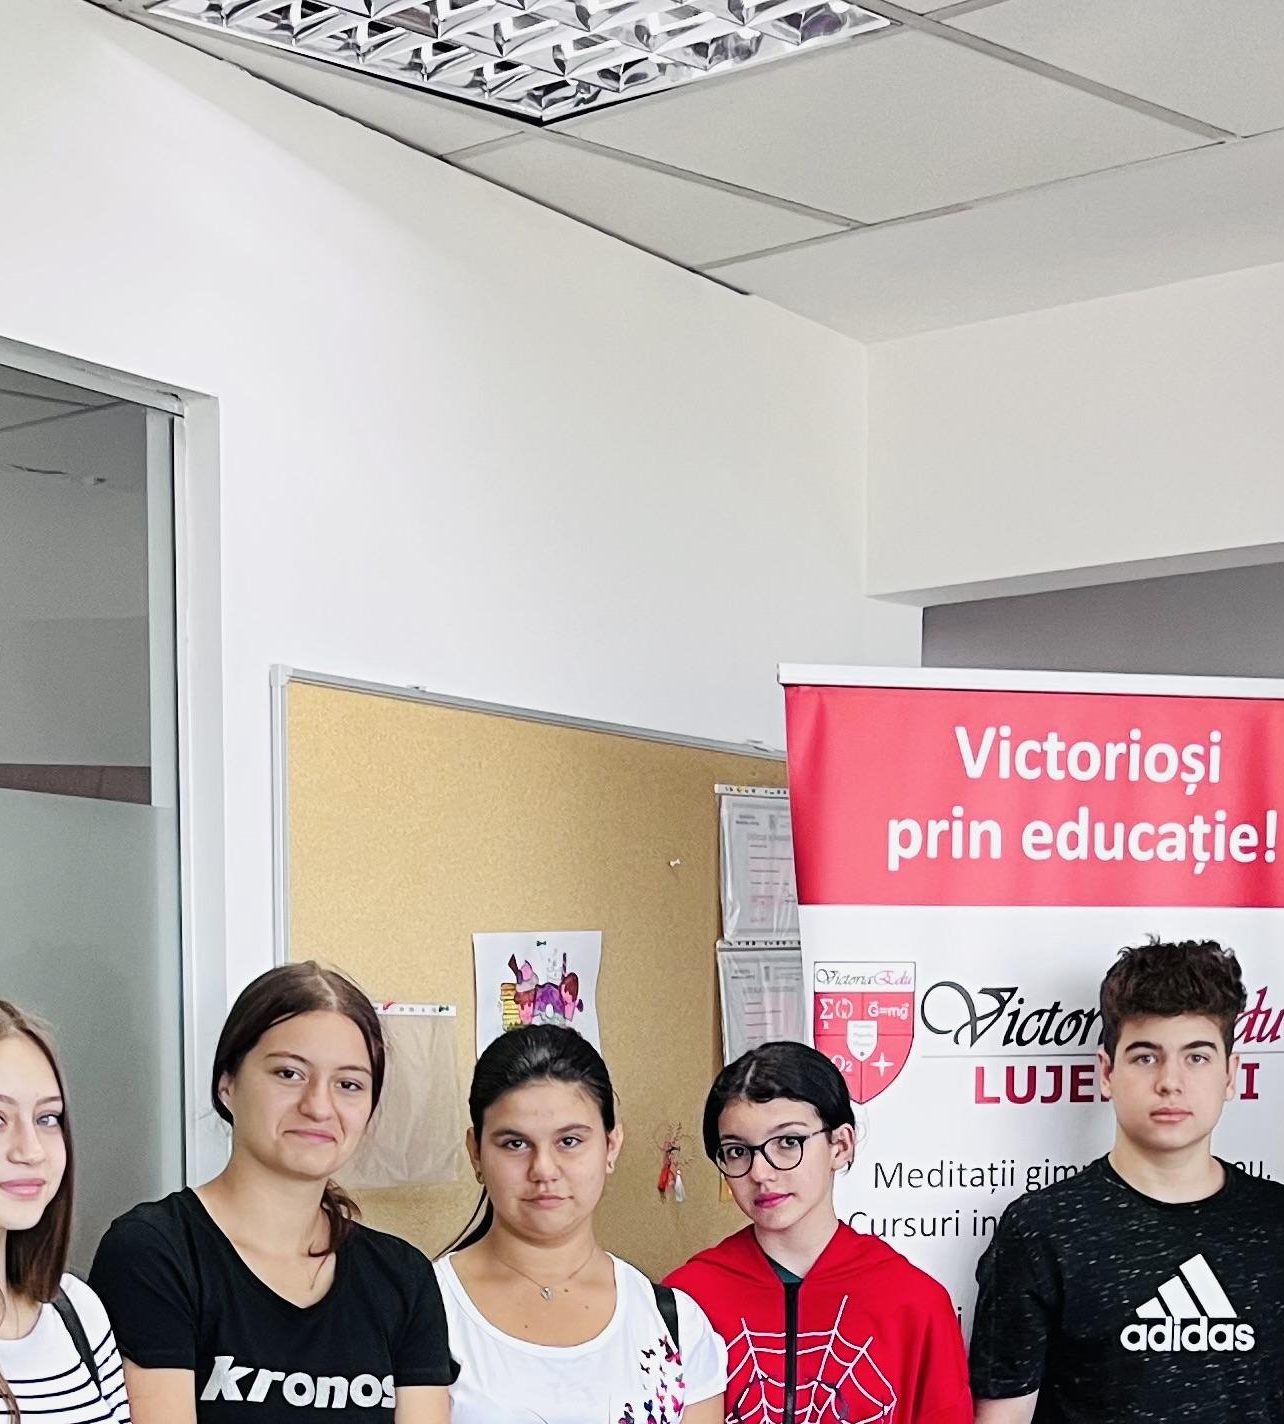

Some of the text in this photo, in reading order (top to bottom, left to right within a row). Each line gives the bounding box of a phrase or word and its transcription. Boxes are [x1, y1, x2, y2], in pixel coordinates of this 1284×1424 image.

[954, 725, 1221, 795] Victorioși
[888, 806, 1277, 875] prin educație!
[874, 1158, 1089, 1195] Meditații gim
[849, 1209, 1003, 1237] Cursuri in
[1120, 1316, 1255, 1351] adidas
